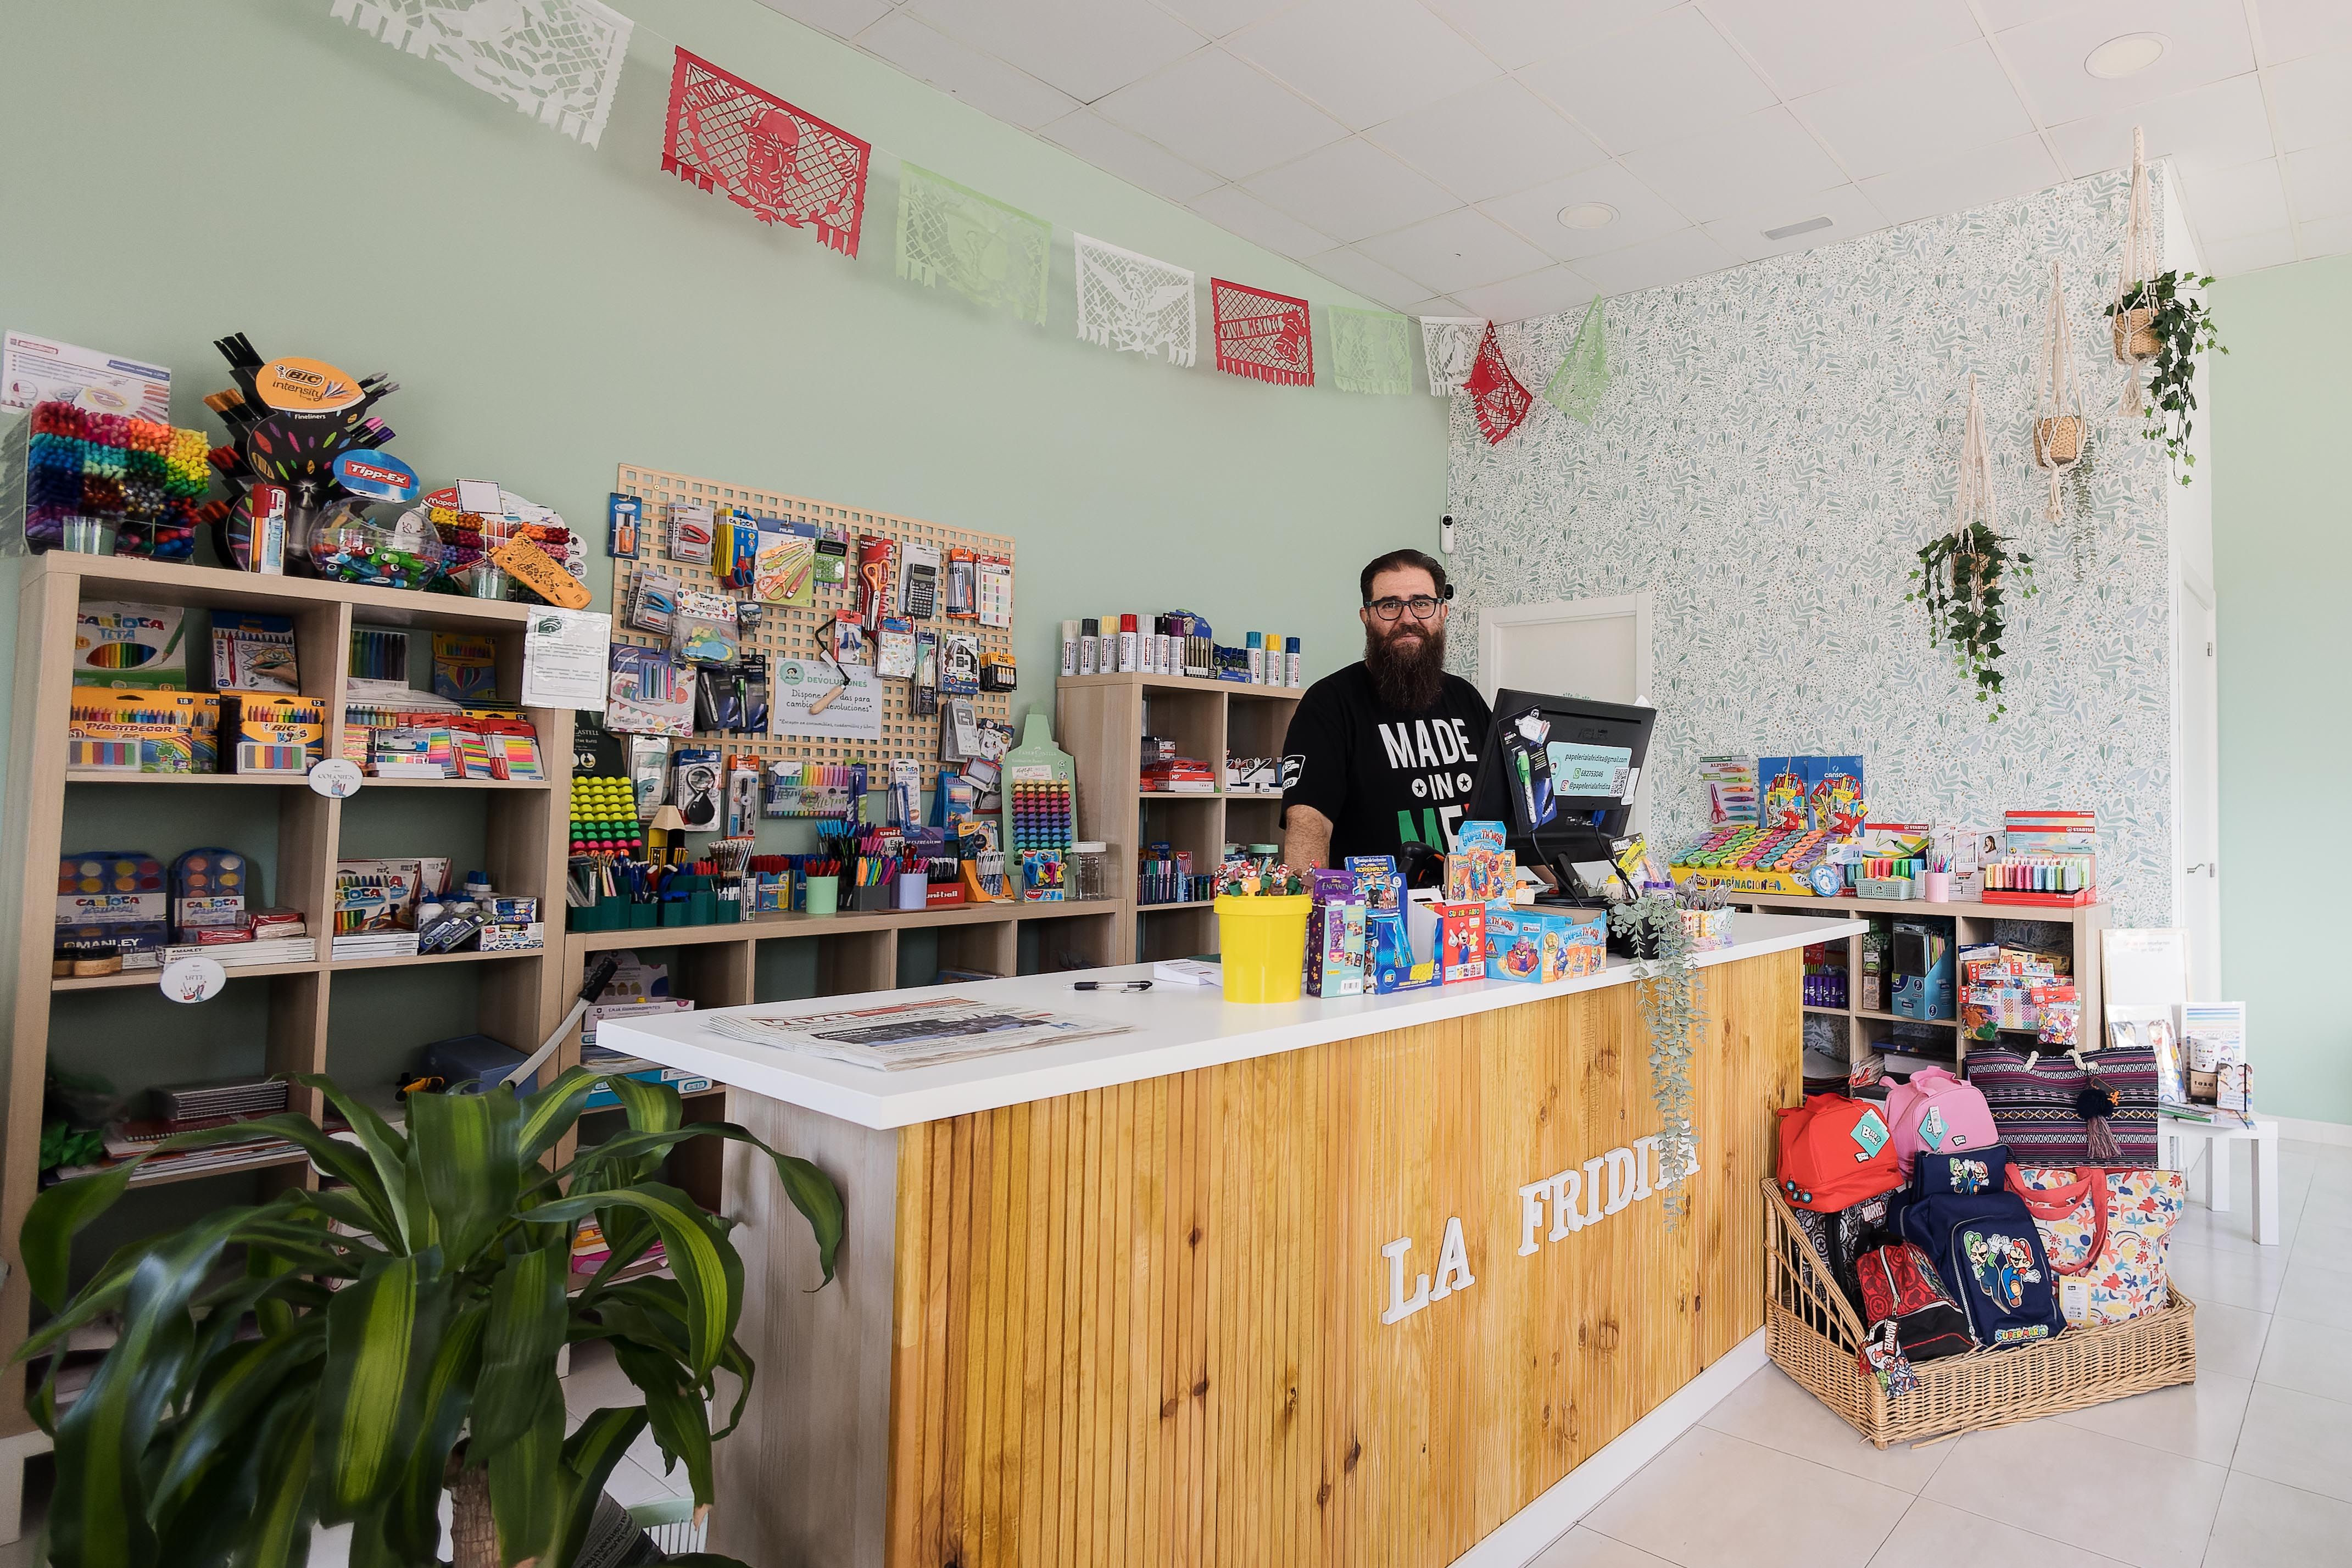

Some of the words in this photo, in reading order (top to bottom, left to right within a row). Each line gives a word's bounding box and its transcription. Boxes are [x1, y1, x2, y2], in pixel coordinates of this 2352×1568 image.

[288, 370, 322, 384] BIC
[272, 381, 324, 401] intensity
[351, 464, 405, 484] Tipp-Ex
[428, 497, 458, 507] Maped
[807, 676, 867, 687] DEVOLUCONES
[86, 722, 173, 733] PLASTIDECOR
[1378, 718, 1478, 769] MADE
[1565, 753, 1628, 764] papelerialafridita@gmail.com
[1428, 773, 1454, 800] IN
[1569, 782, 1610, 790] @papelerialafridita
[336, 886, 381, 902] RIOCA
[1322, 882, 1349, 891] ENCANTO
[76, 896, 140, 906] CARIOCA
[187, 899, 238, 908] CARIOCA
[1485, 916, 1514, 931] ERTHINGS
[1862, 1201, 1886, 1221] MARVEL
[1381, 1216, 1476, 1325] LA
[1884, 1319, 1897, 1352] MARVEL
[1996, 1327, 2022, 1342] SUPER
[2021, 1325, 2047, 1338] MARIO
